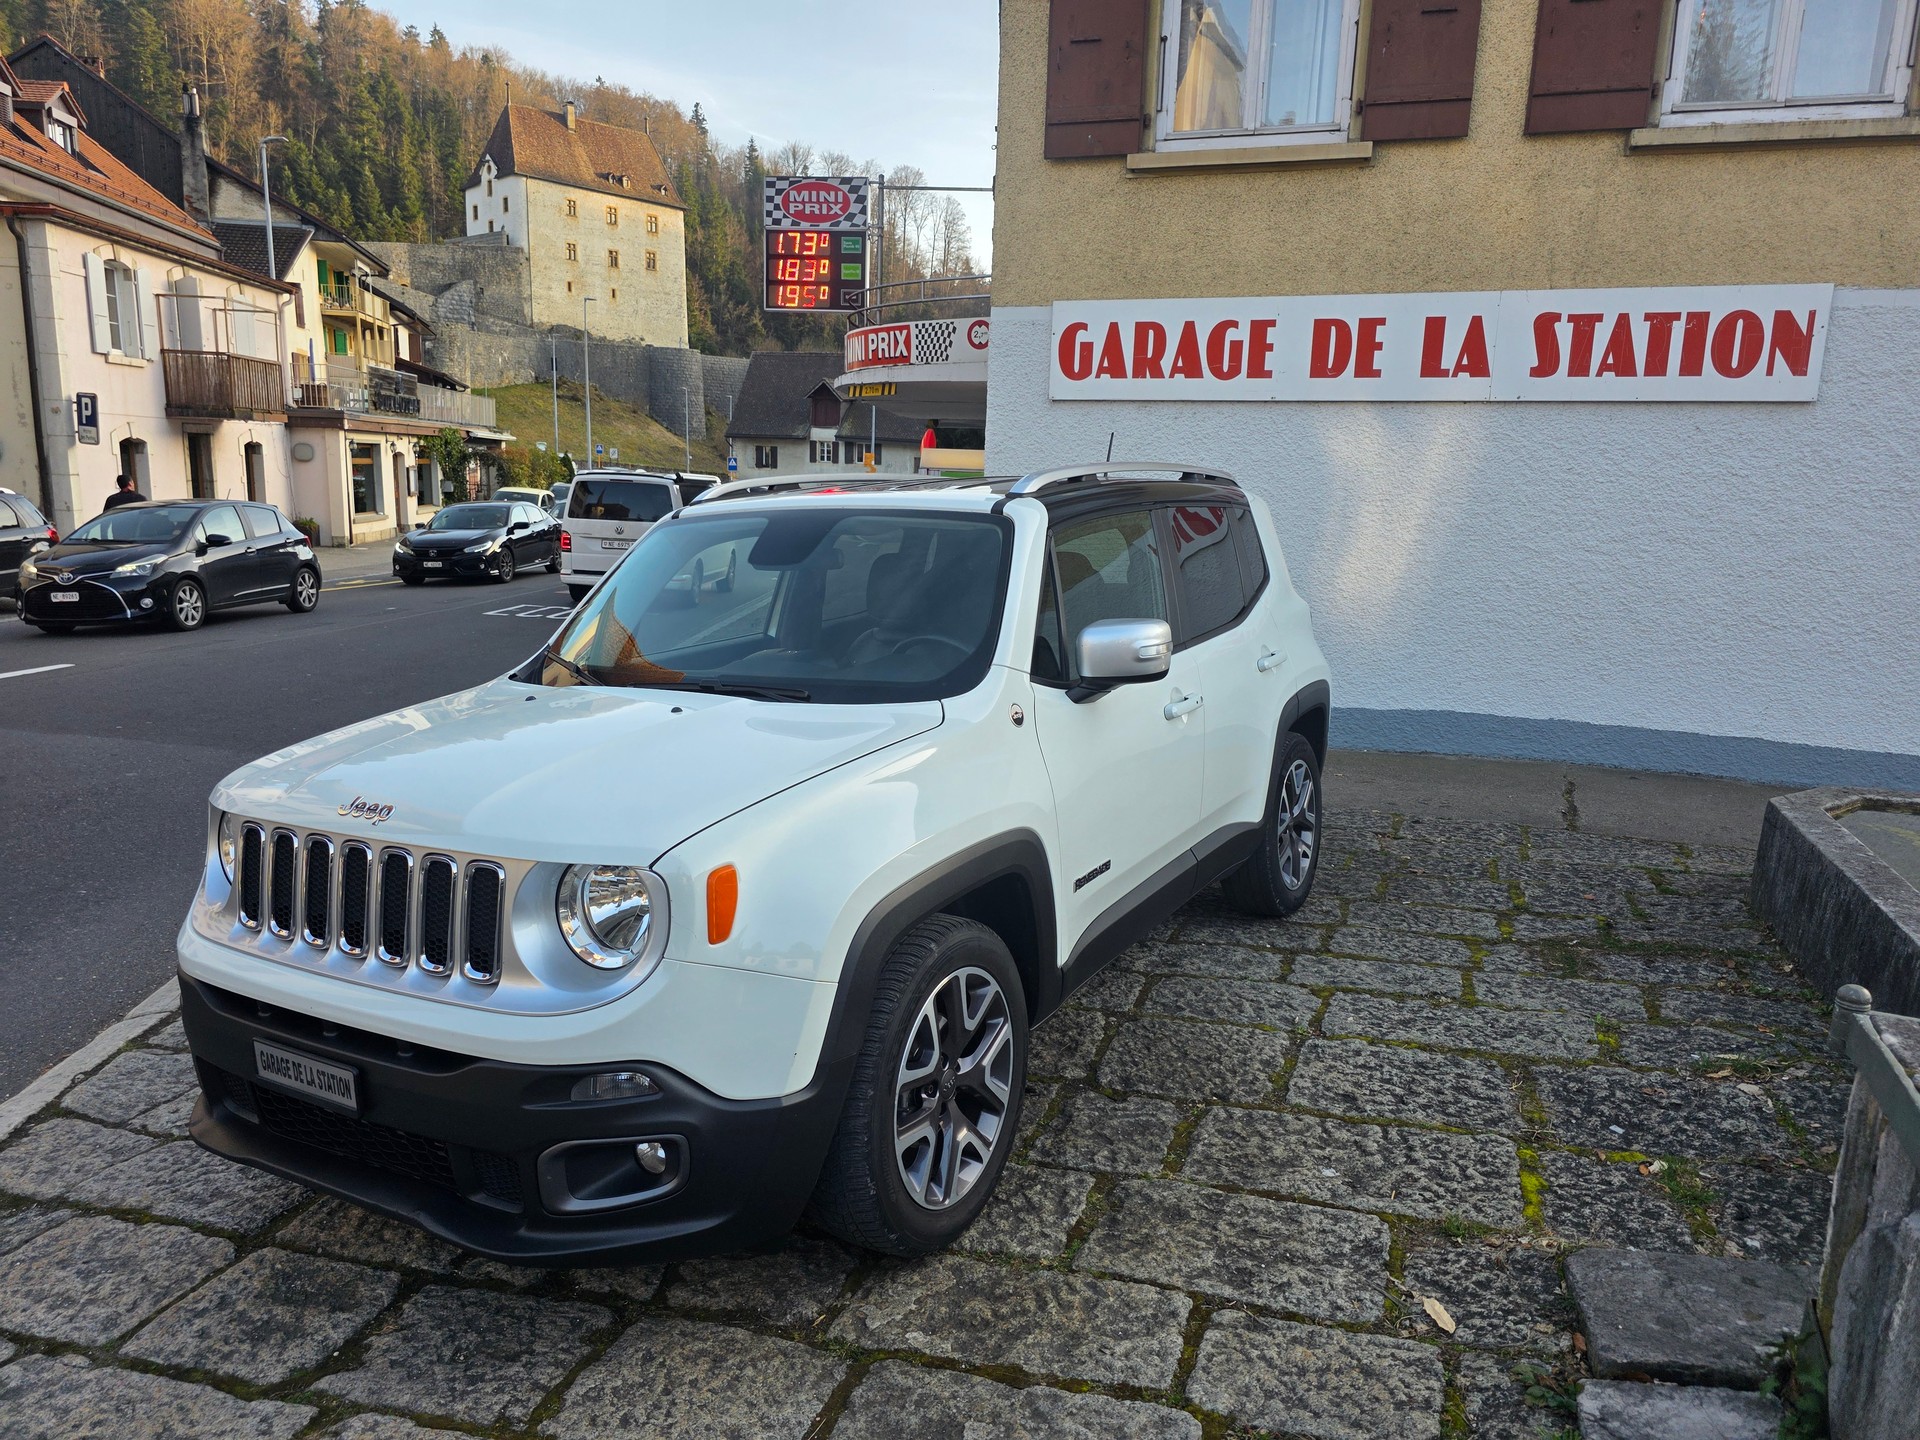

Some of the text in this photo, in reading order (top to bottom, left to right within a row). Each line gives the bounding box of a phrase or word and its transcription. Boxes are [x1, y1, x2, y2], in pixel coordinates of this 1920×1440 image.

[788, 190, 844, 203] MINI
[788, 203, 844, 215] PRIX
[847, 329, 908, 364] MINI PRIX
[1058, 309, 1817, 381] GARAGE DE LA STATION
[81, 397, 92, 424] P
[337, 796, 394, 826] Jeep
[260, 1050, 352, 1101] GARAGE DE LA STATION
